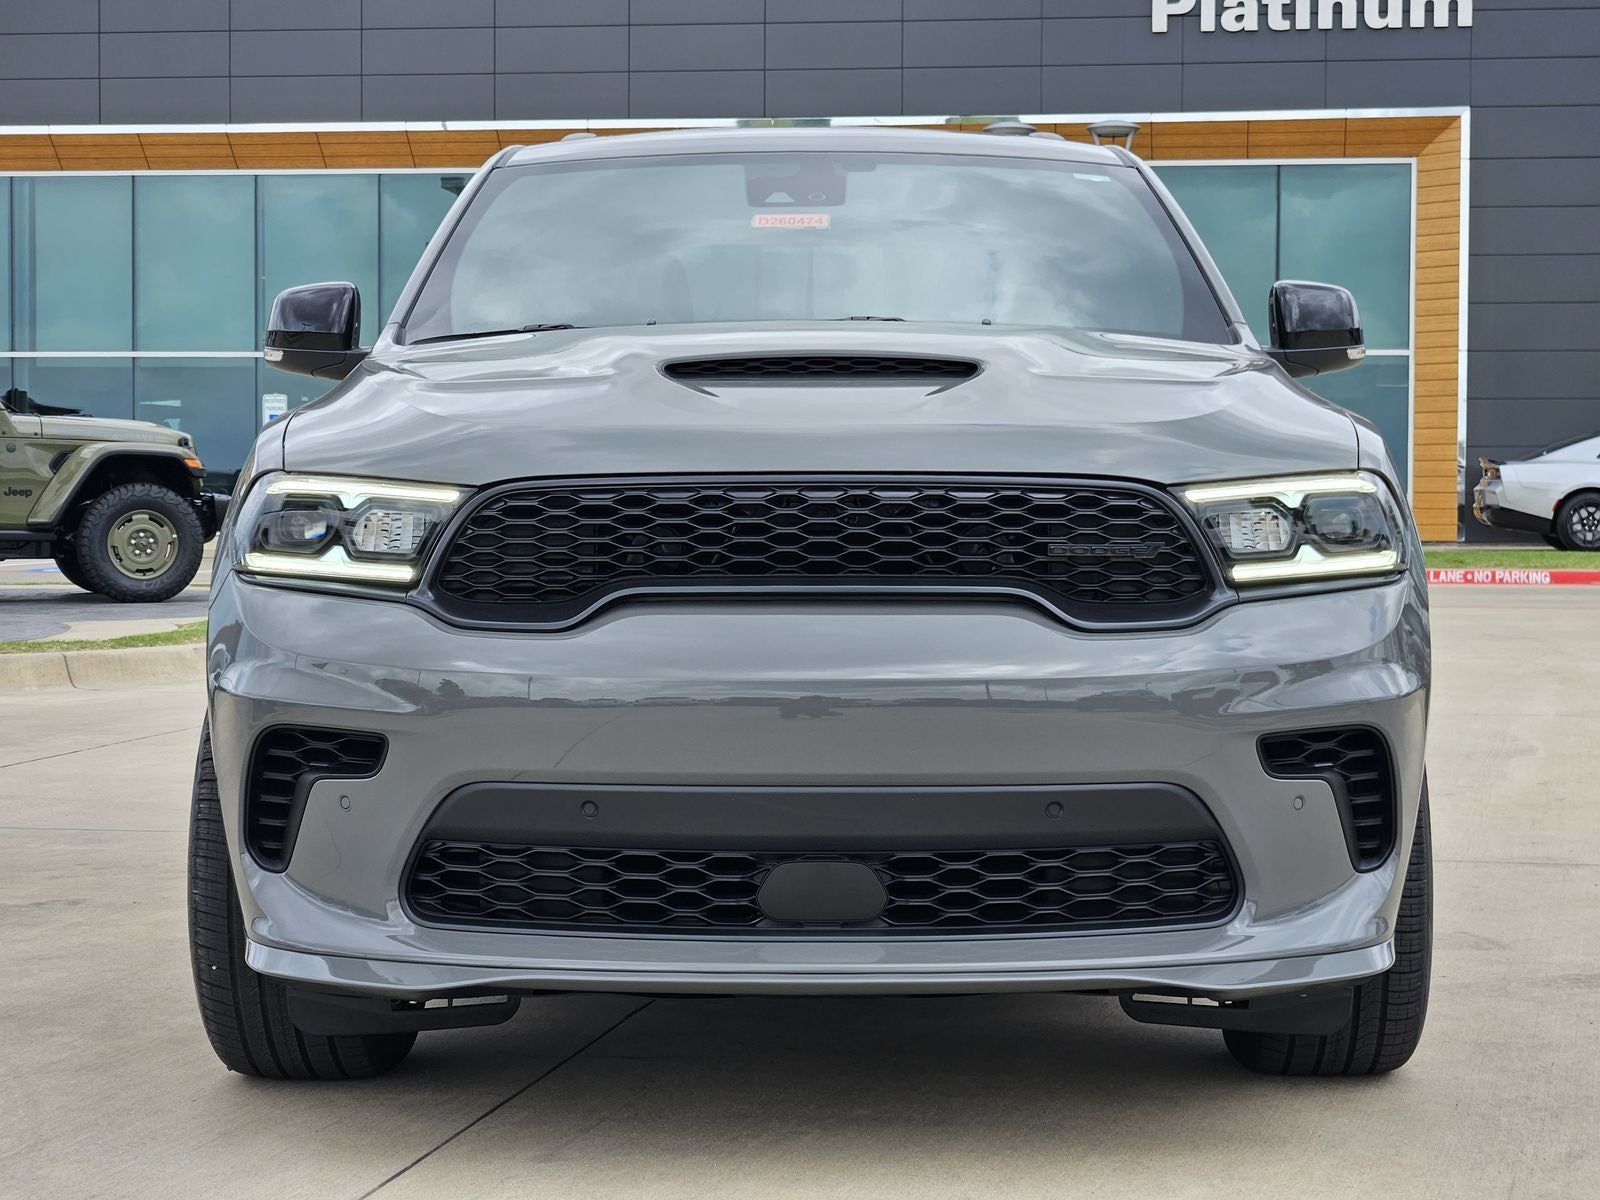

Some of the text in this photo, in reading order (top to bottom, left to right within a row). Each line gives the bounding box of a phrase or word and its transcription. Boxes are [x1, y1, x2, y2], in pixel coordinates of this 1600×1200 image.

[1151, 0, 1473, 33] Platinum
[759, 216, 824, 225] D260474
[3, 486, 33, 498] Jeep
[1049, 544, 1150, 555] DODGE
[1429, 571, 1465, 583] LANE
[1495, 571, 1550, 584] PARKING
